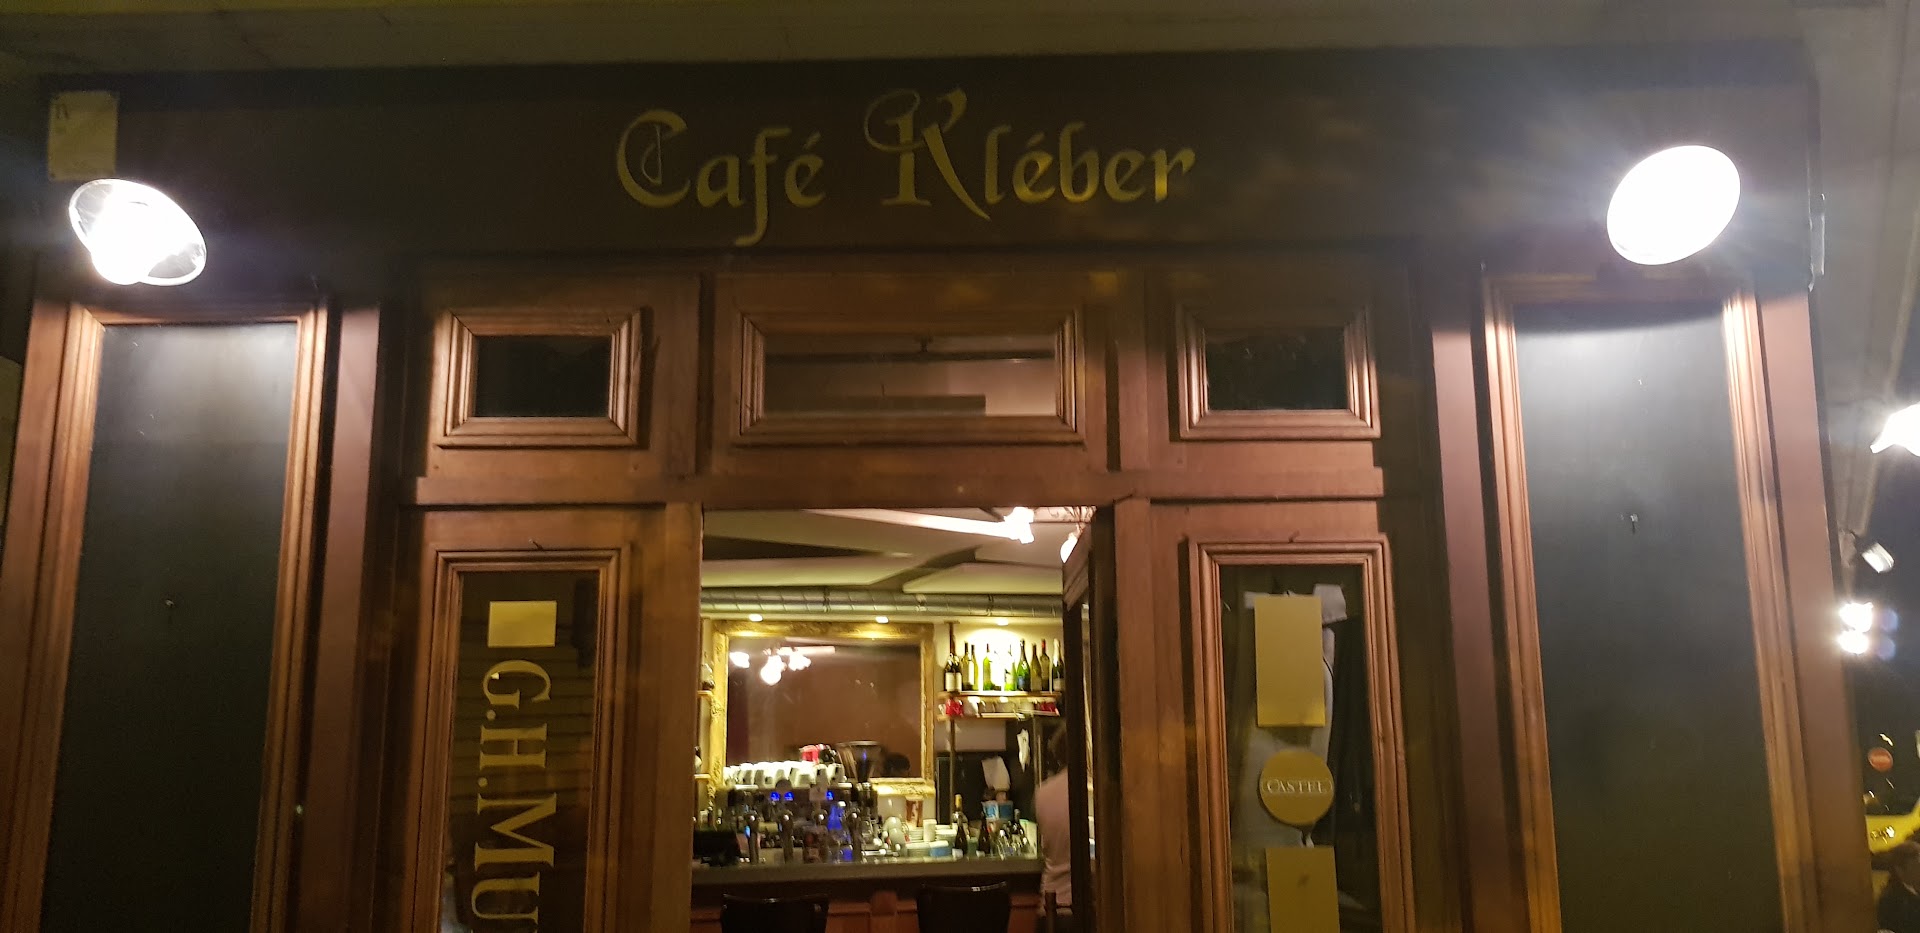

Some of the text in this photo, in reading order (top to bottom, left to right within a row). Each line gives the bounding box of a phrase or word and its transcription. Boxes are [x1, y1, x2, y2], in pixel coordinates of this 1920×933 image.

[616, 88, 1196, 247] Café Kléber
[470, 659, 557, 933] G.H.MU
[1266, 778, 1328, 794] CASTEL
